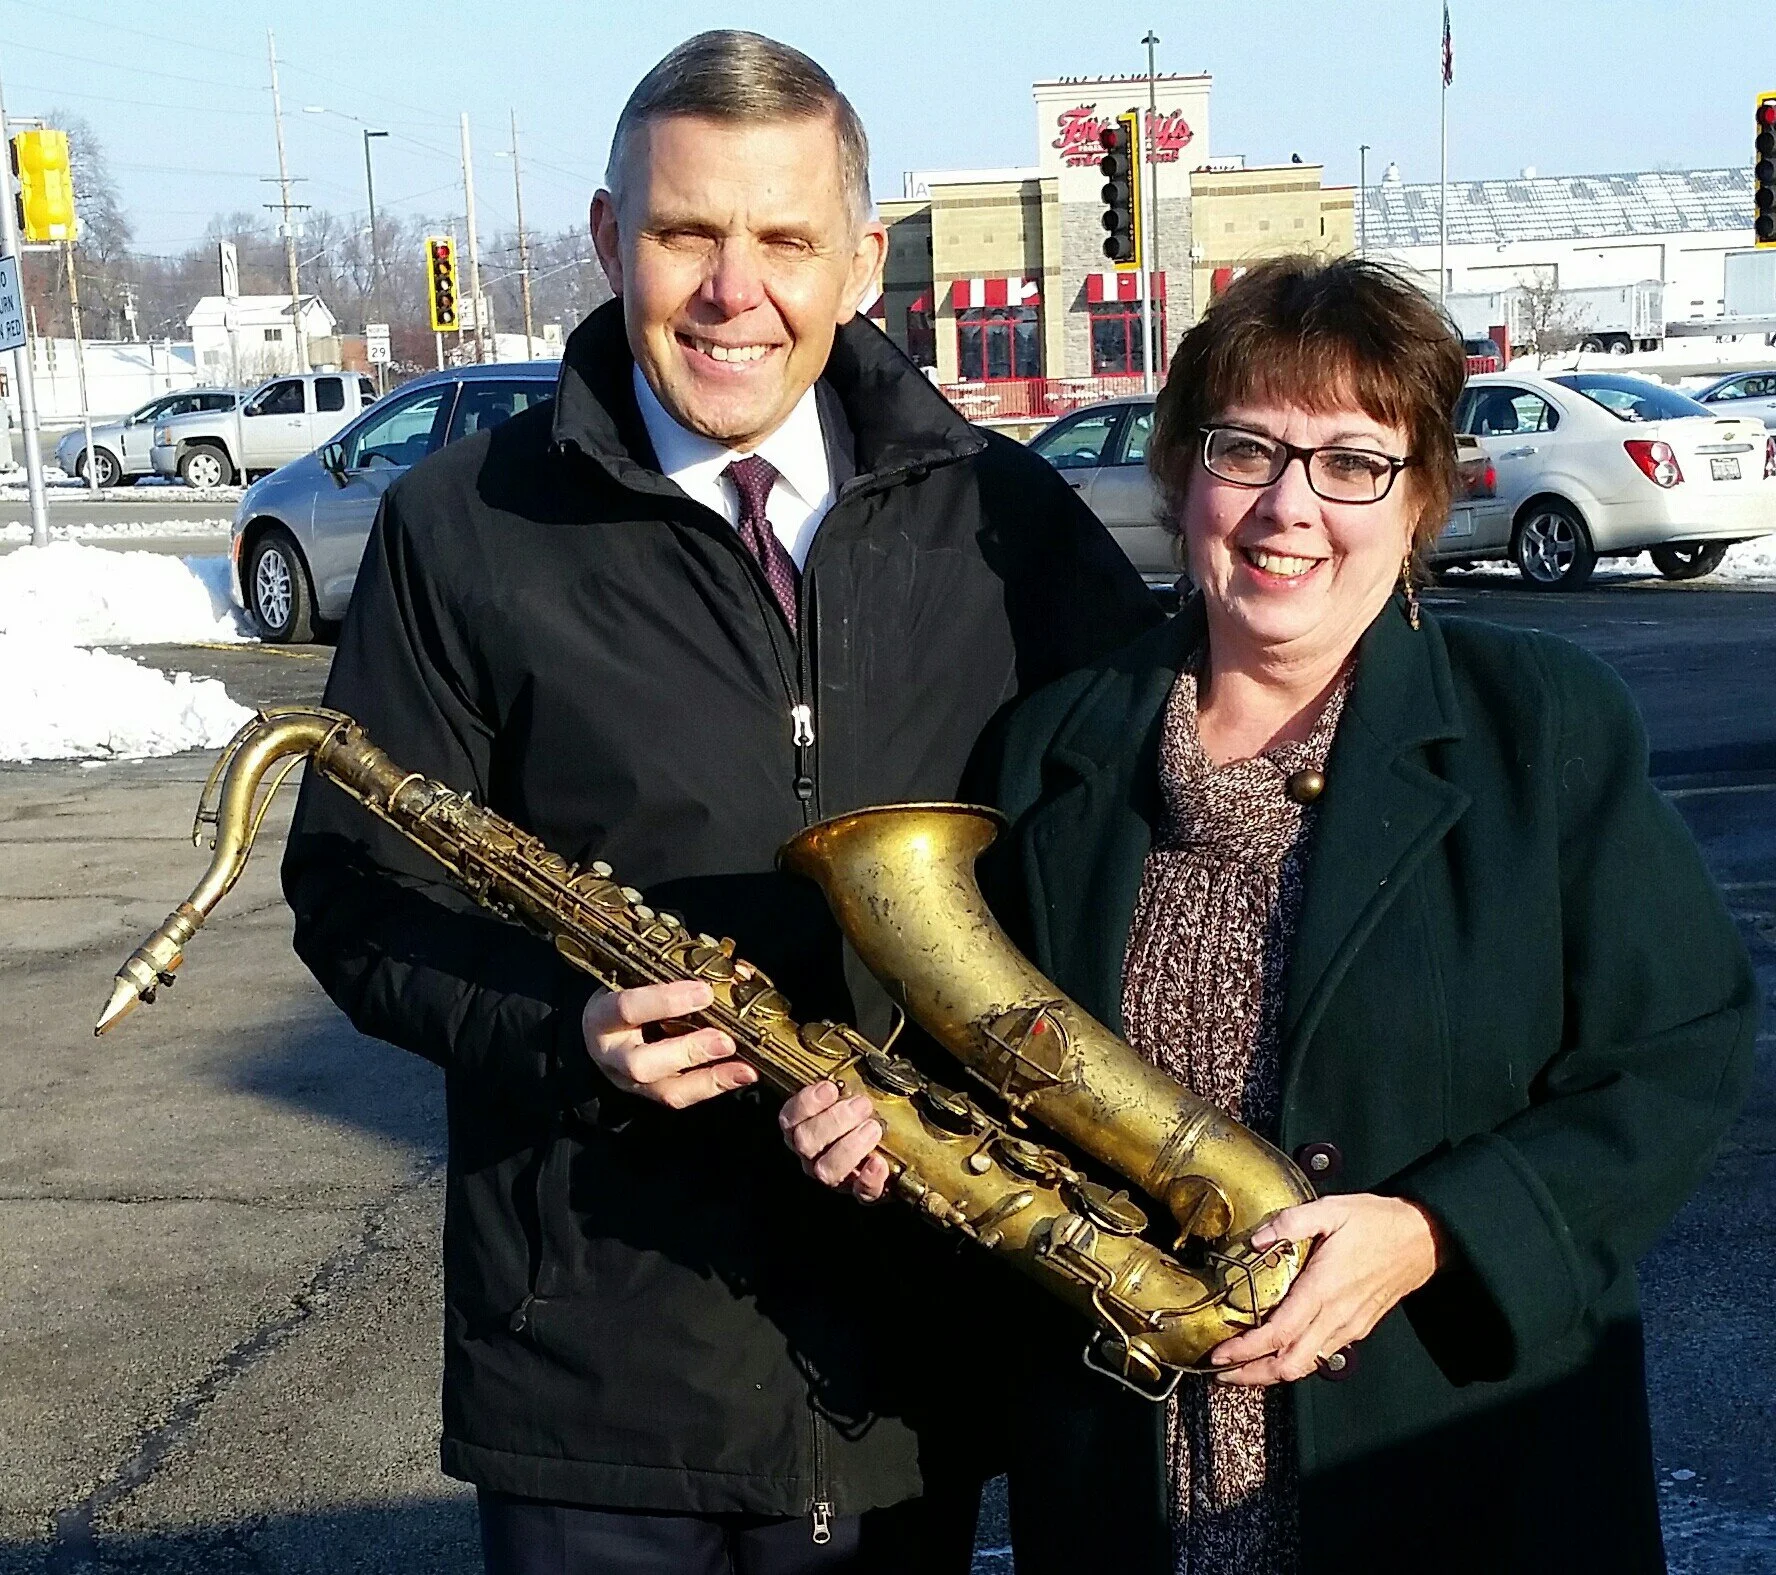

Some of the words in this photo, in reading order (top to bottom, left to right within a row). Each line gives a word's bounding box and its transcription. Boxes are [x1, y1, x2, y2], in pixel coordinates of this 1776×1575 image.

[0, 271, 7, 288] O
[0, 294, 14, 314] URN
[6, 319, 21, 340] RED
[371, 347, 386, 358] 29
